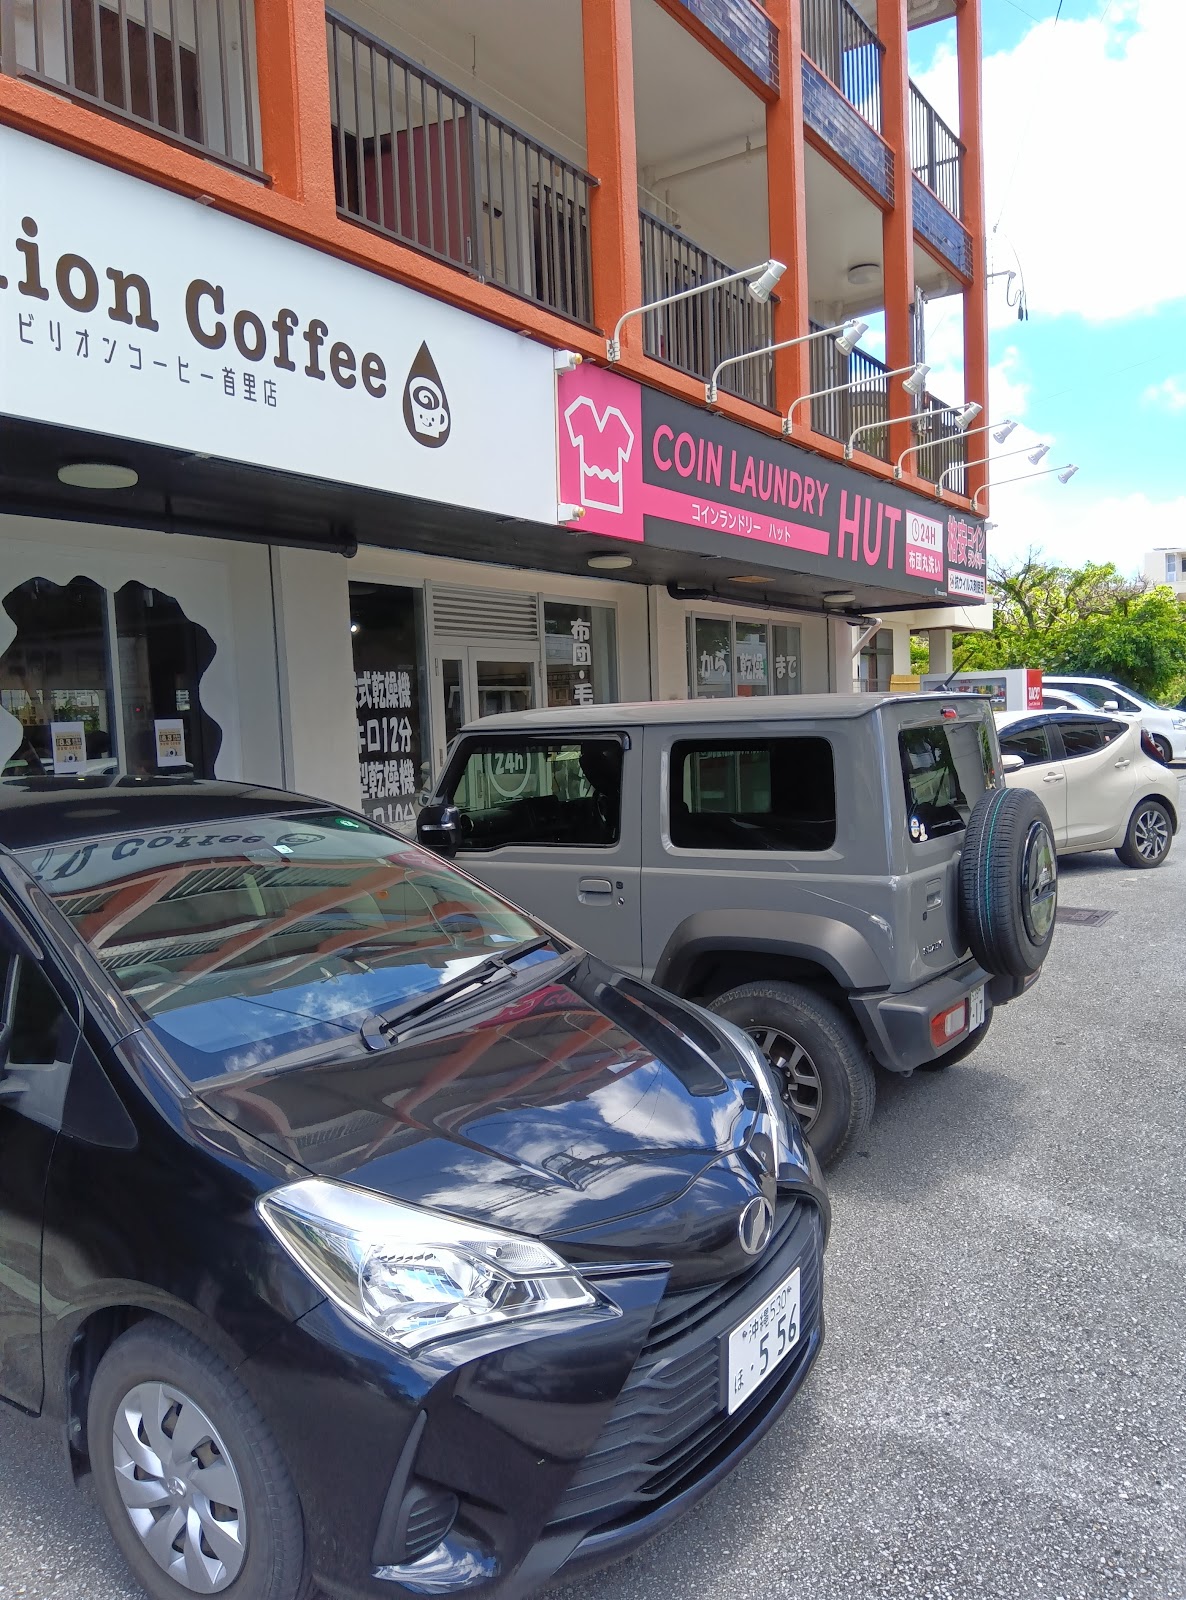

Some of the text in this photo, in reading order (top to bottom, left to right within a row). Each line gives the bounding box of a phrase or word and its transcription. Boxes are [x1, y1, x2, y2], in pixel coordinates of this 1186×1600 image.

[18, 312, 278, 408] ビリオンコーヒー首里店
[185, 278, 387, 399] Coffee
[653, 424, 829, 517] COIN LAUNDRY
[691, 503, 791, 542] コインランドリー ハット
[837, 489, 902, 570] HUT
[920, 523, 936, 546] 24H
[355, 670, 412, 709] 式乾燥機
[700, 650, 797, 680] から 乾燥 まで
